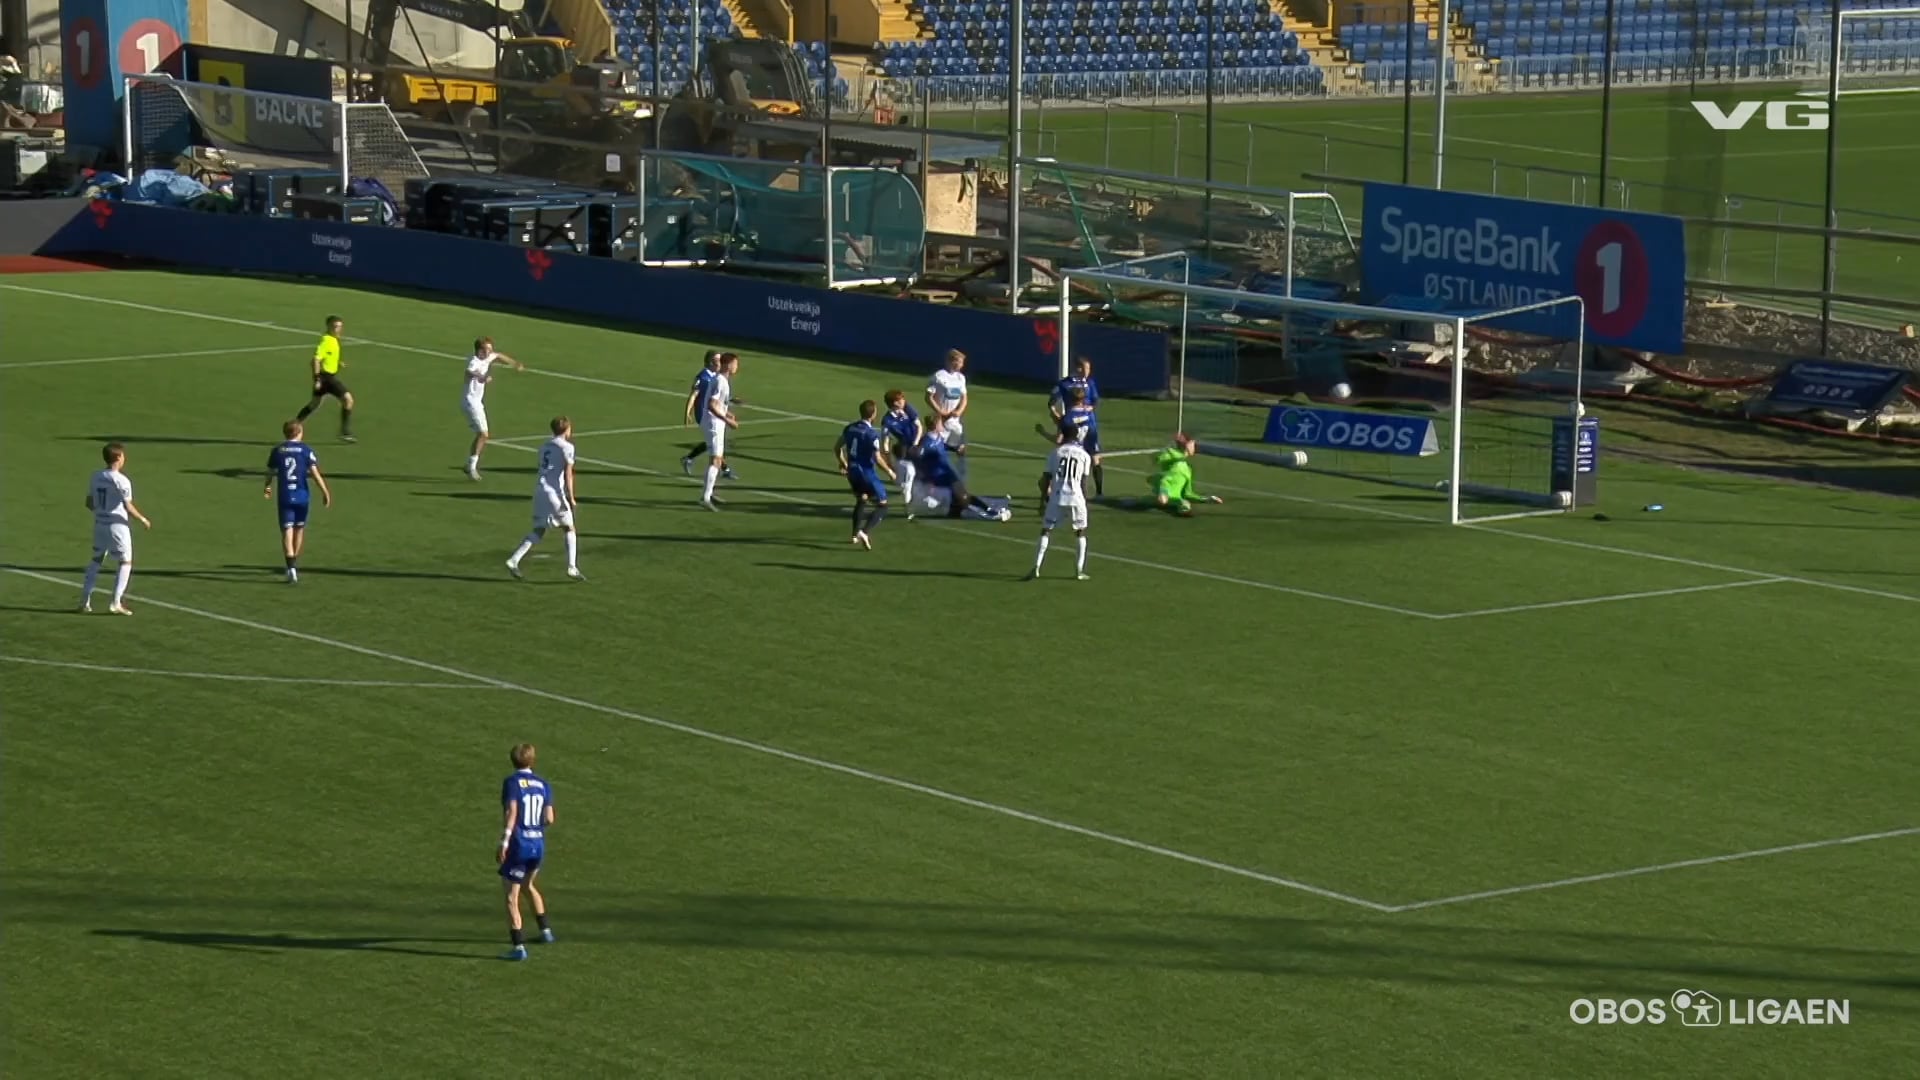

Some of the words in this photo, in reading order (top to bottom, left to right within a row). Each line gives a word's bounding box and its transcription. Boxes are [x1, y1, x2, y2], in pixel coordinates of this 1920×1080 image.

[76, 30, 91, 75] 1
[136, 32, 160, 74] 1
[255, 97, 324, 128] BACKE
[1380, 206, 1561, 275] SpareBank
[1596, 242, 1622, 314] 1
[1424, 272, 1561, 316] ØSTLANDET
[791, 316, 820, 335] Energi
[1327, 421, 1415, 450] OBOS
[285, 457, 297, 480] 2
[522, 794, 544, 826] 10
